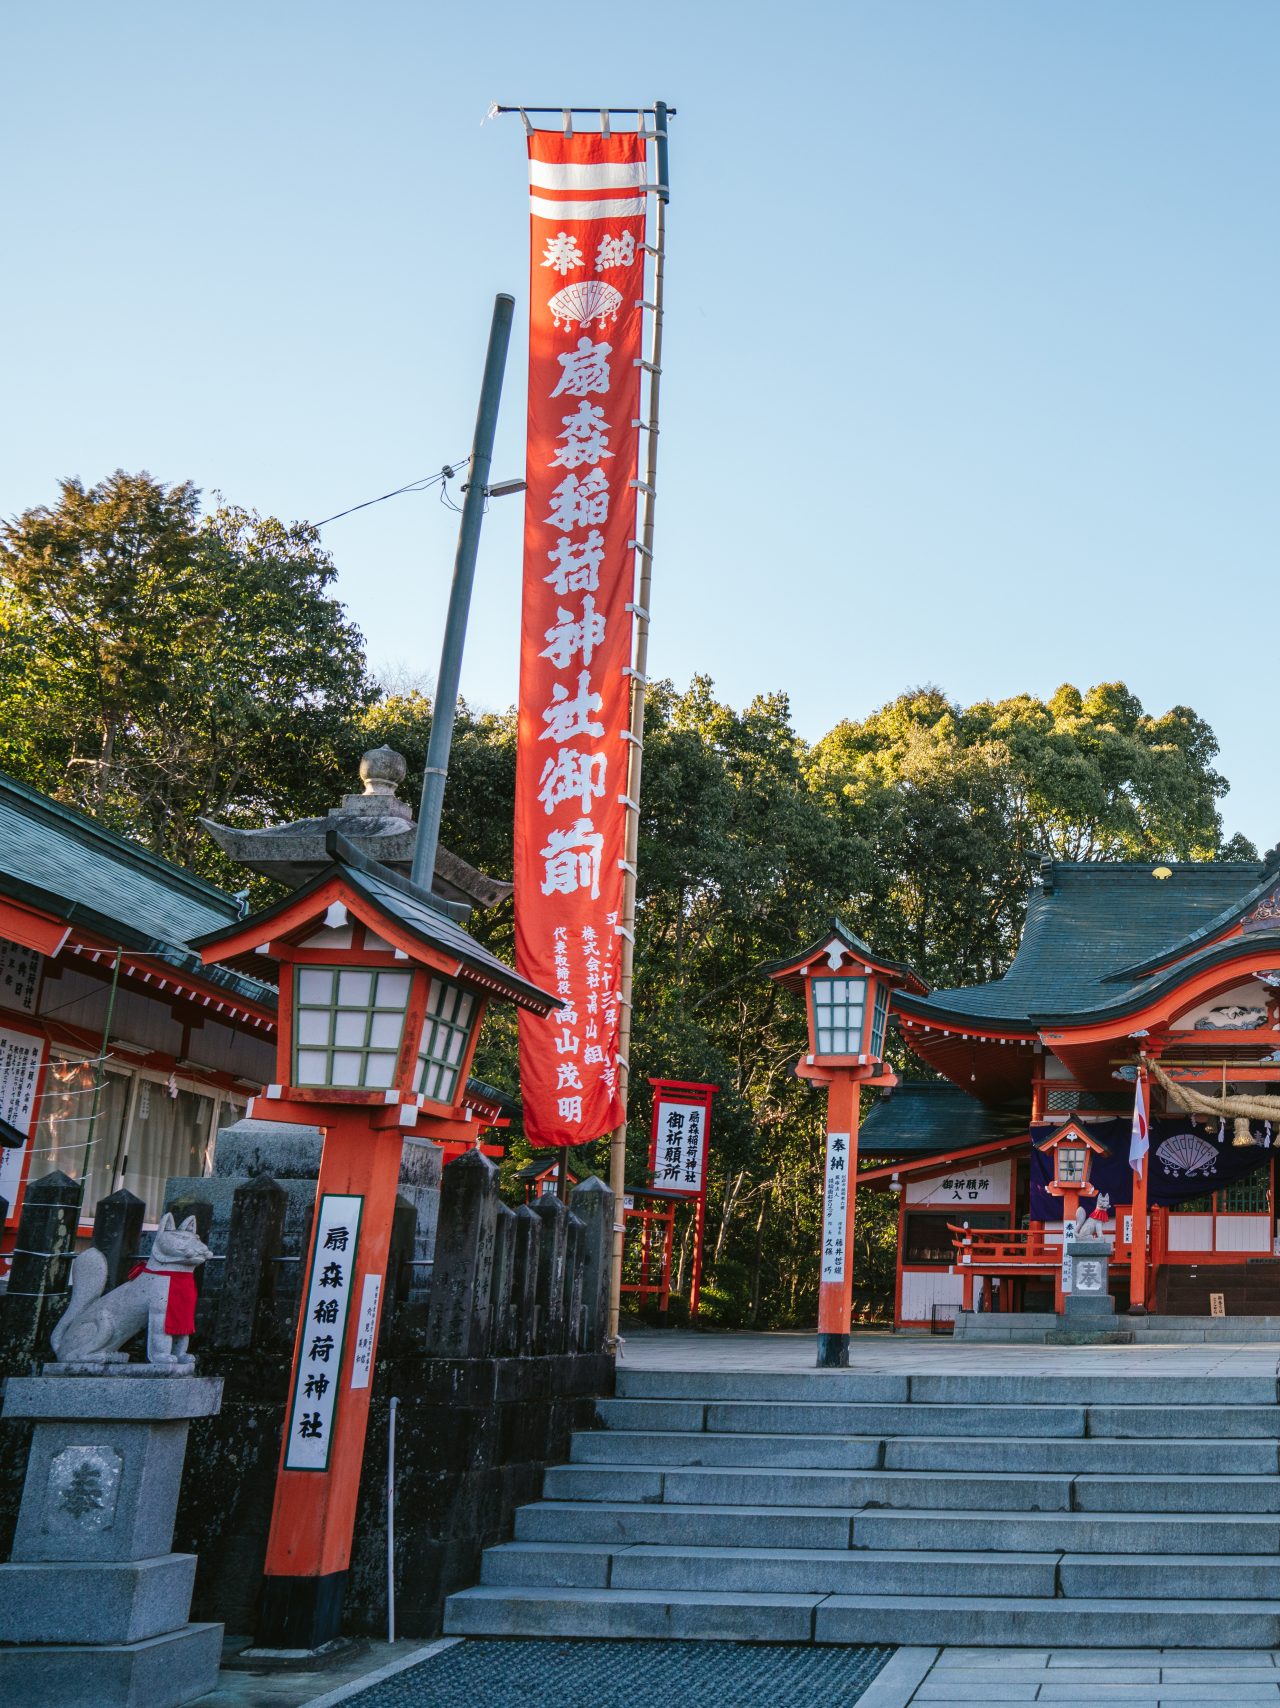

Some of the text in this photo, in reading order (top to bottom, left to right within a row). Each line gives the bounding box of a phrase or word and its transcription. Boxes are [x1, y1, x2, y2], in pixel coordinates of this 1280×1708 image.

[540, 230, 636, 276] 奉納
[663, 1111, 685, 1182] 御祈願所
[830, 1138, 846, 1170] 奉納
[942, 1179, 989, 1190] 御祈願所
[952, 1191, 978, 1200] 入口
[1079, 1263, 1100, 1287] 奉
[298, 1226, 350, 1440] 扇森稲荷神社
